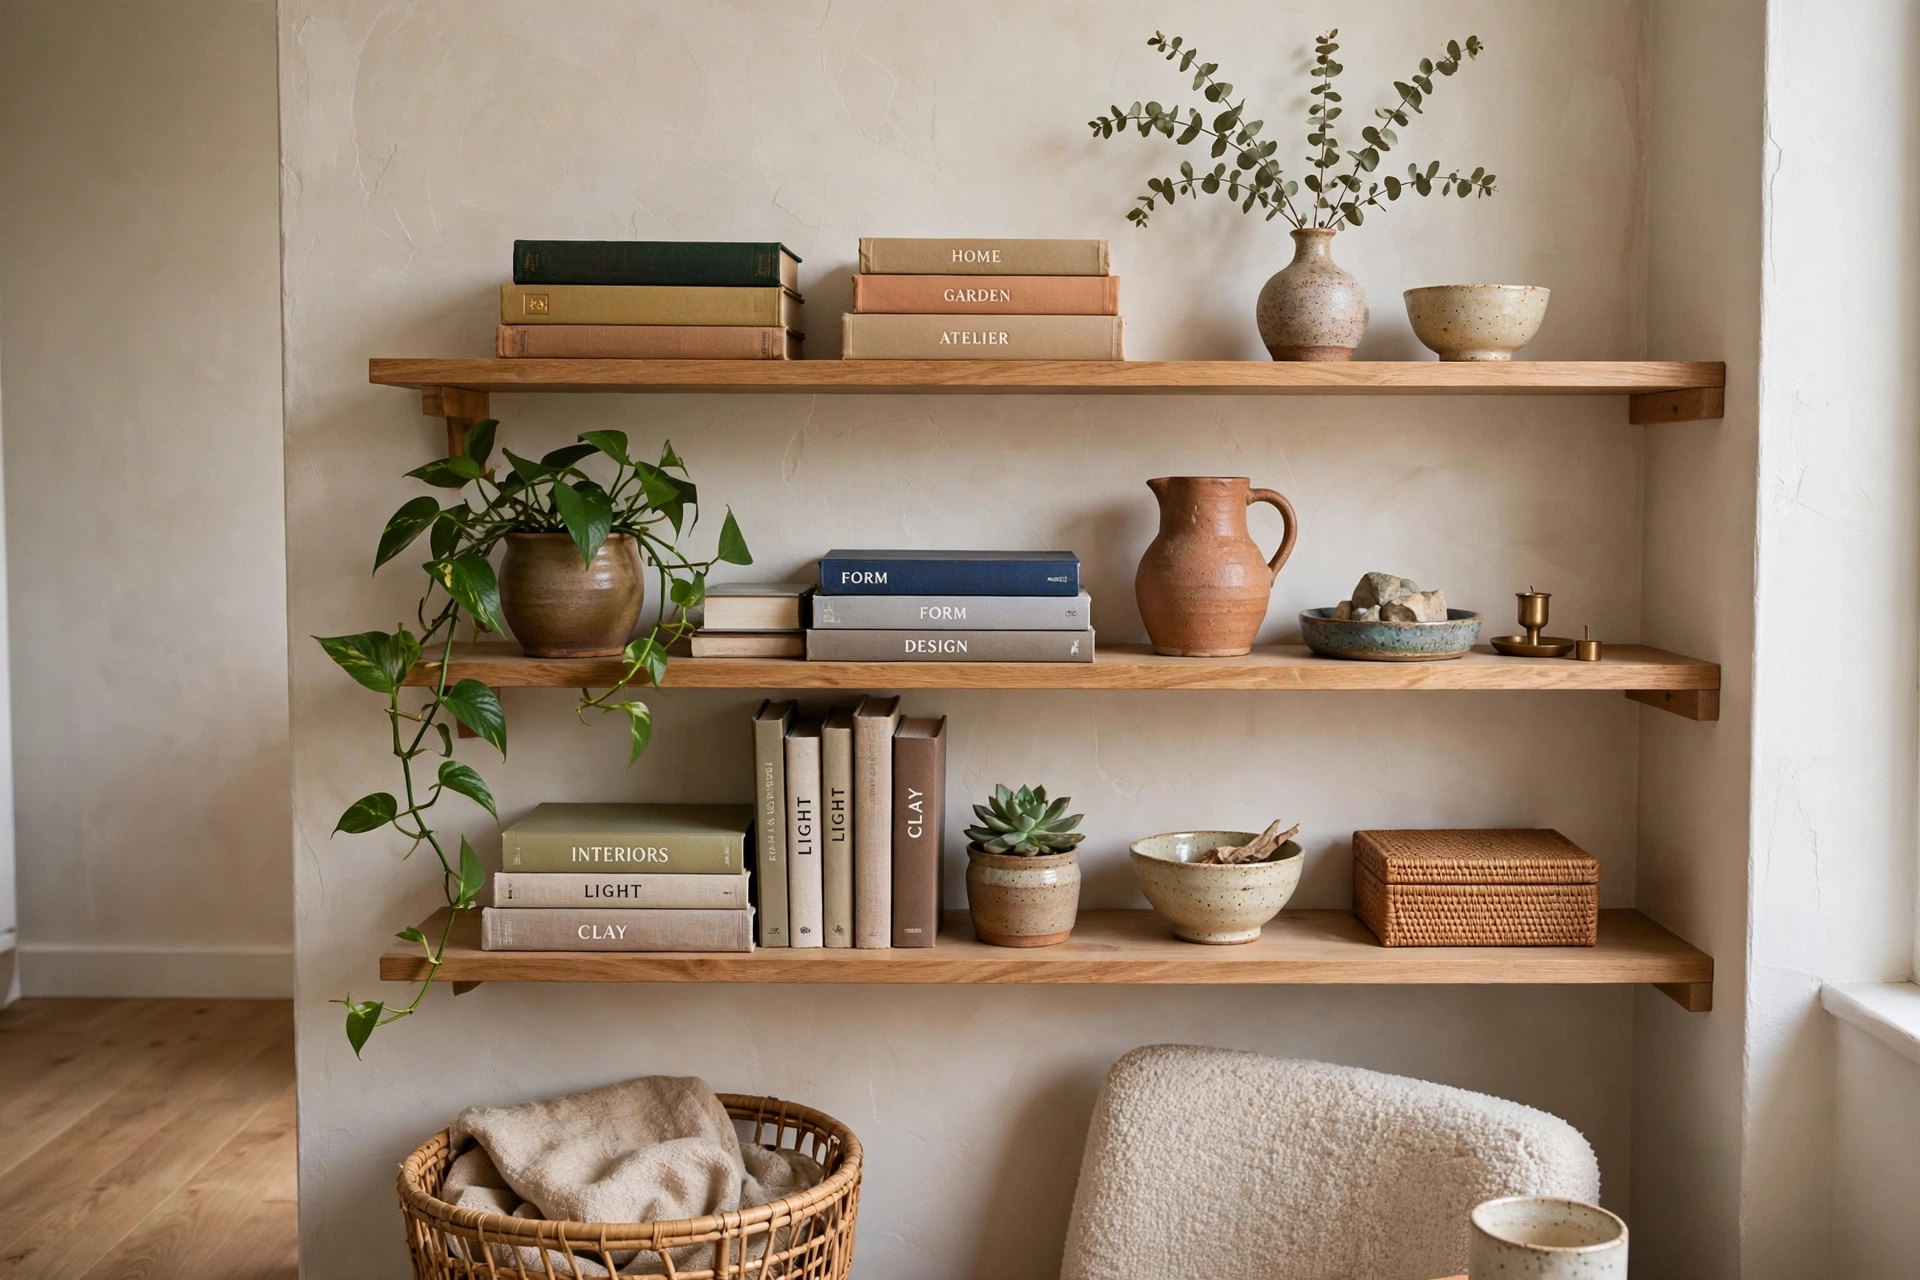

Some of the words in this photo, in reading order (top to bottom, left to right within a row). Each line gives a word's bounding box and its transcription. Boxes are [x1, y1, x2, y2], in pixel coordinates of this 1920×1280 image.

[952, 249, 1002, 263] HOME
[944, 288, 1011, 302] GARDEN
[939, 331, 1009, 345] ATELIER
[841, 571, 888, 584] FORM
[920, 606, 967, 620] FORM
[905, 639, 968, 653] DESIGN
[831, 788, 845, 842] LIGHT
[907, 787, 923, 838] CLAY
[797, 797, 812, 855] LIGHT
[571, 846, 669, 863] INTERIORS
[584, 884, 642, 898] LIGHT
[577, 924, 628, 940] CLAY
